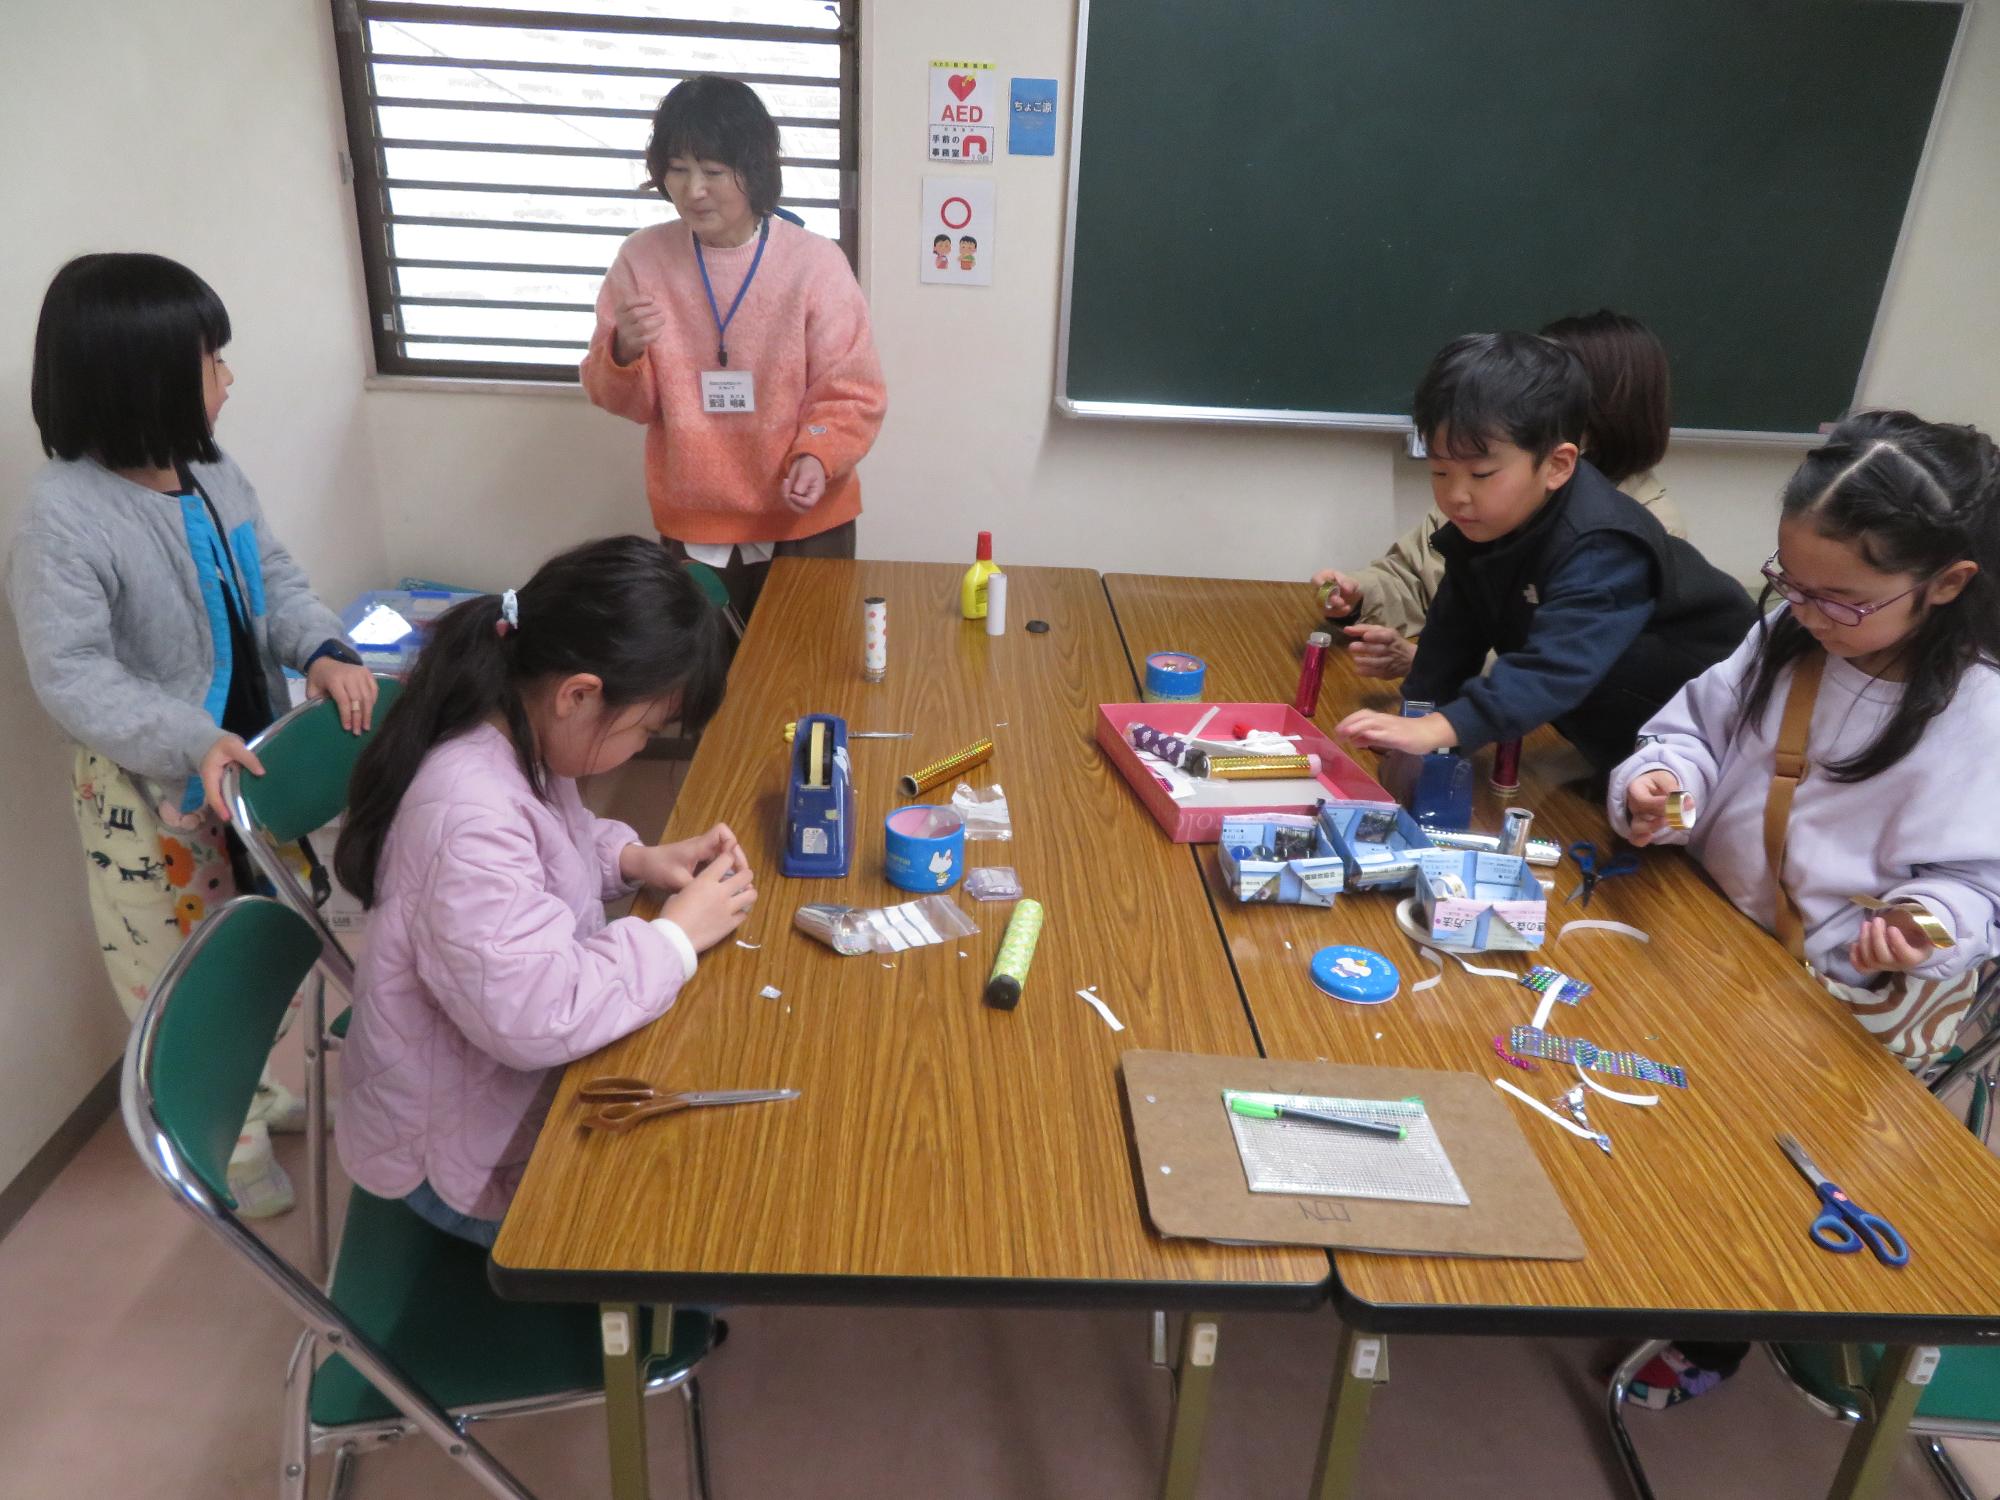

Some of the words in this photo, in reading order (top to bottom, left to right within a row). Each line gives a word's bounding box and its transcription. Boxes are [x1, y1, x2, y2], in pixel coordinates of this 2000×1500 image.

[941, 104, 983, 123] AED
[932, 134, 960, 144] 手前の
[932, 148, 960, 158] 事務室
